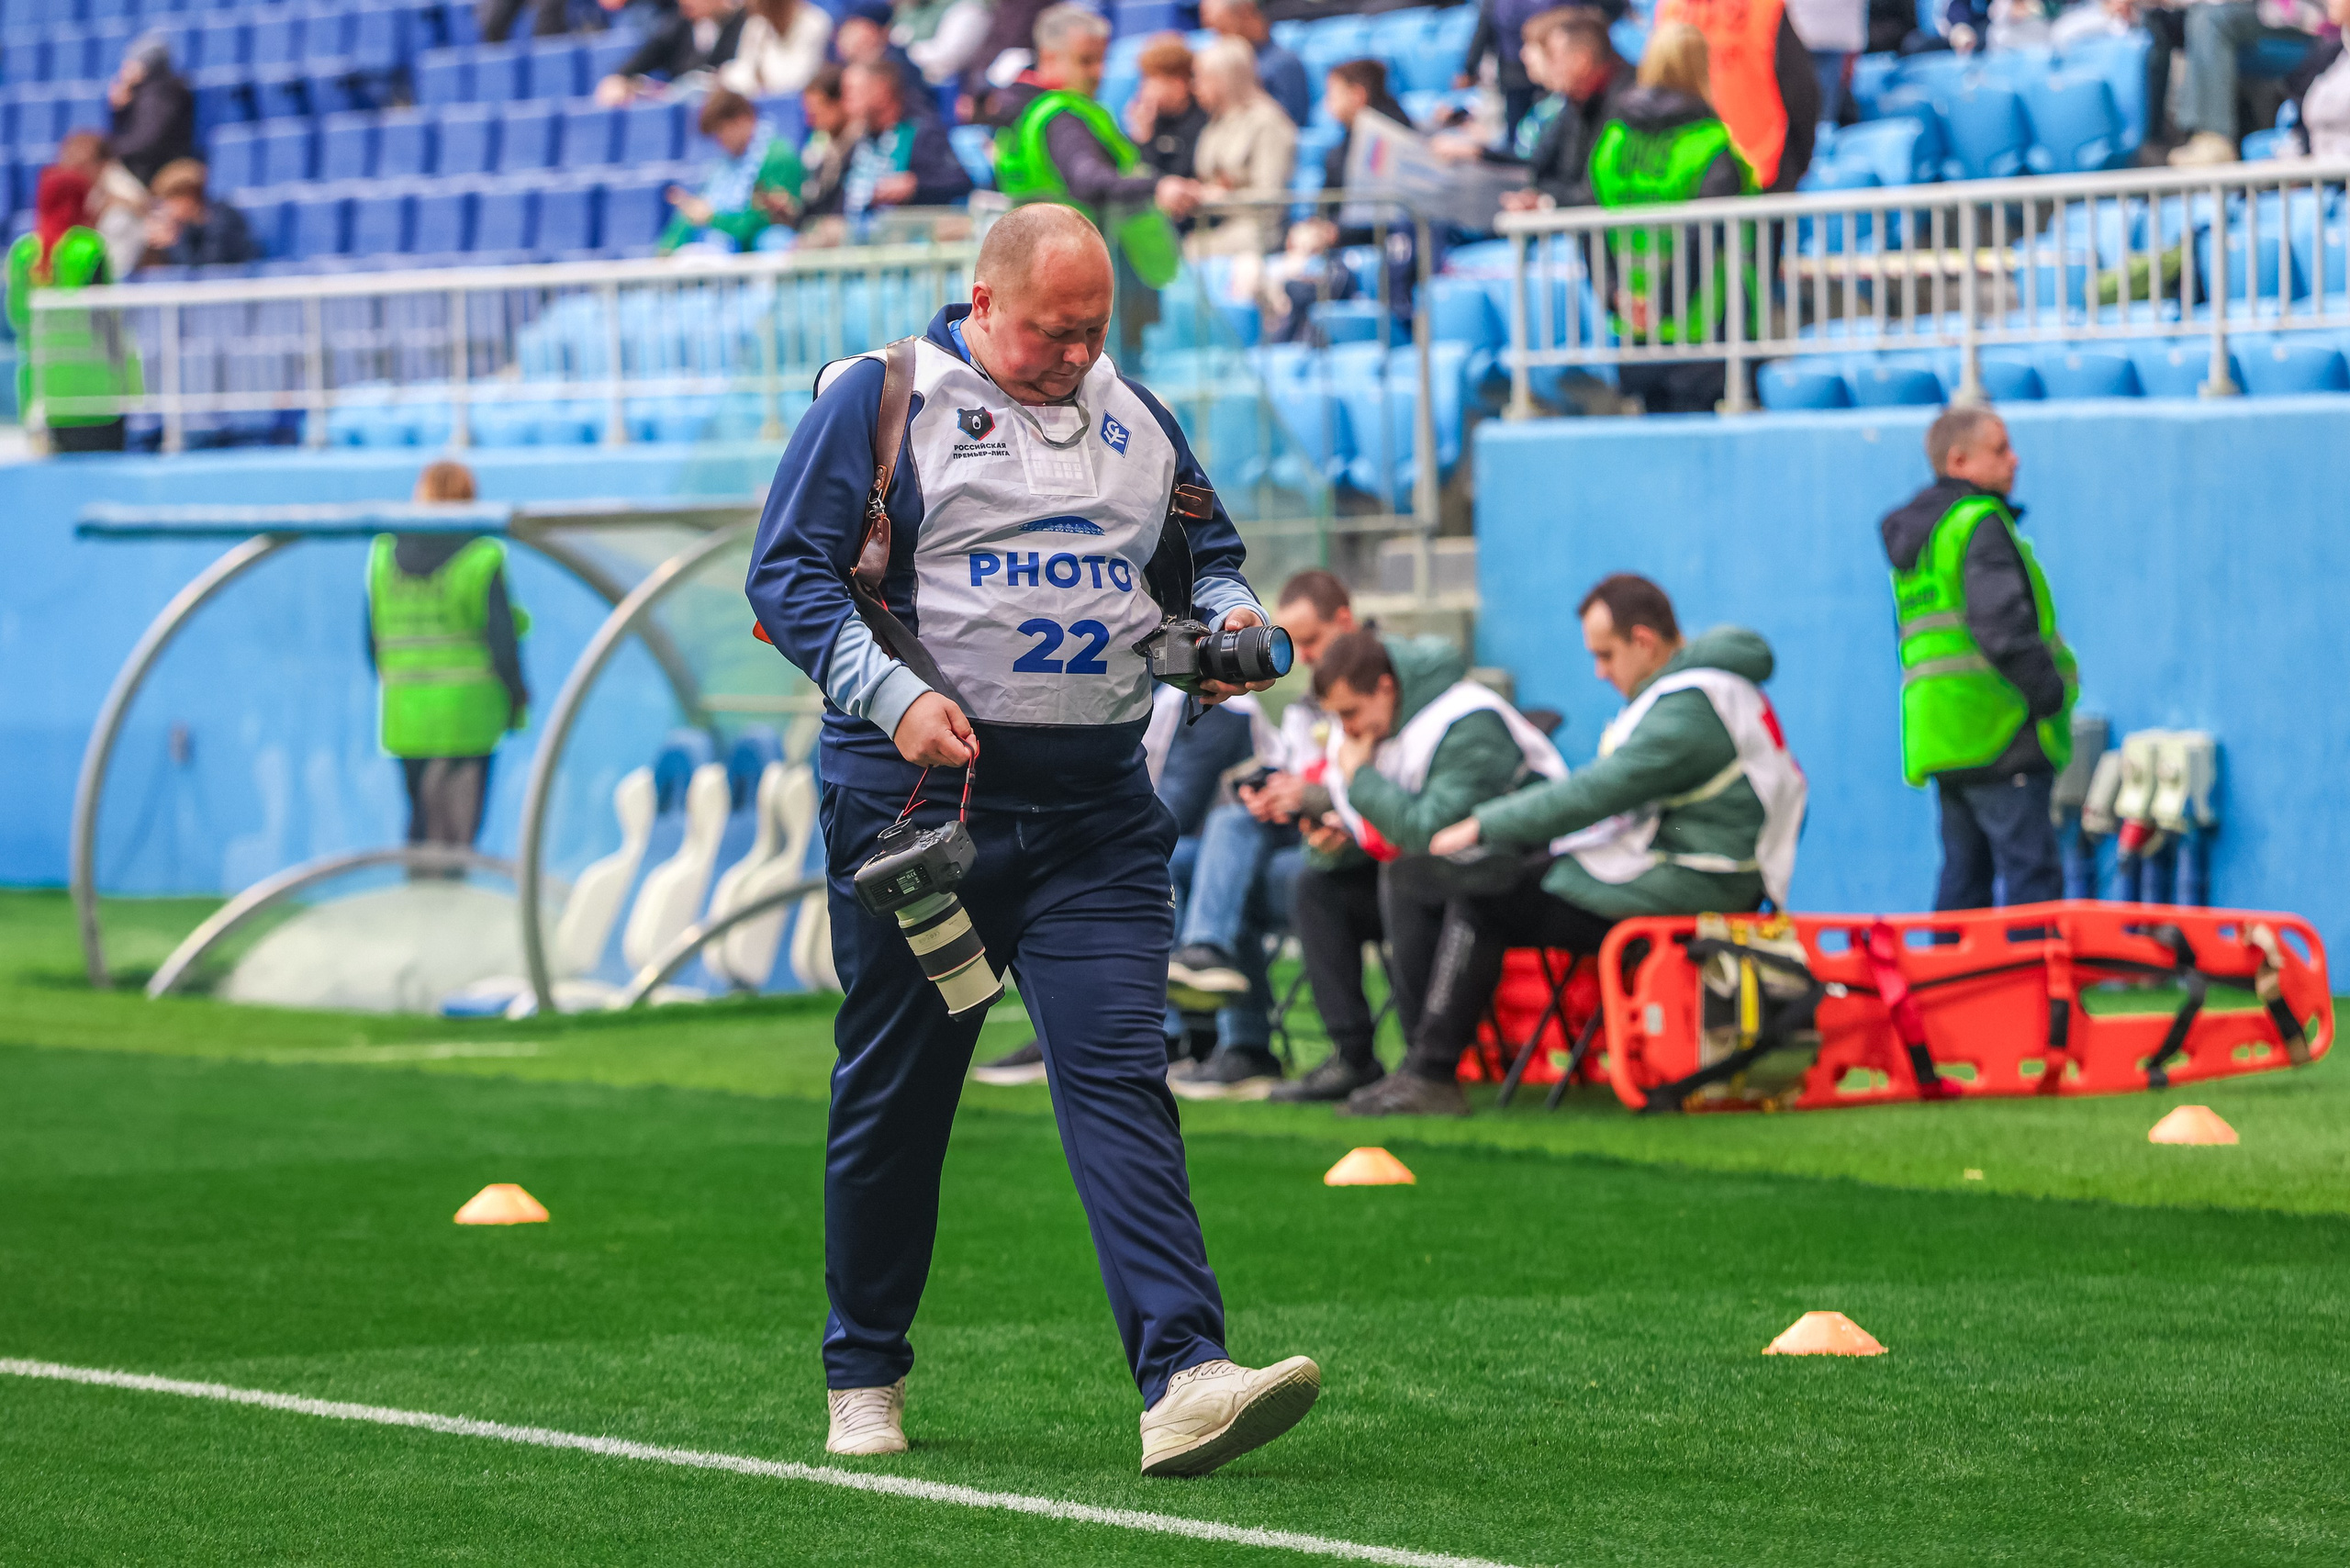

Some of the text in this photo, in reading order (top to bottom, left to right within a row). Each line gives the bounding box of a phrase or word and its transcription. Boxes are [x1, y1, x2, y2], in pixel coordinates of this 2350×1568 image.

[953, 451, 1010, 459] ПРЕМЬЕР-ЛИГА
[969, 552, 1133, 592] PHOTO
[1013, 618, 1110, 674] 22
